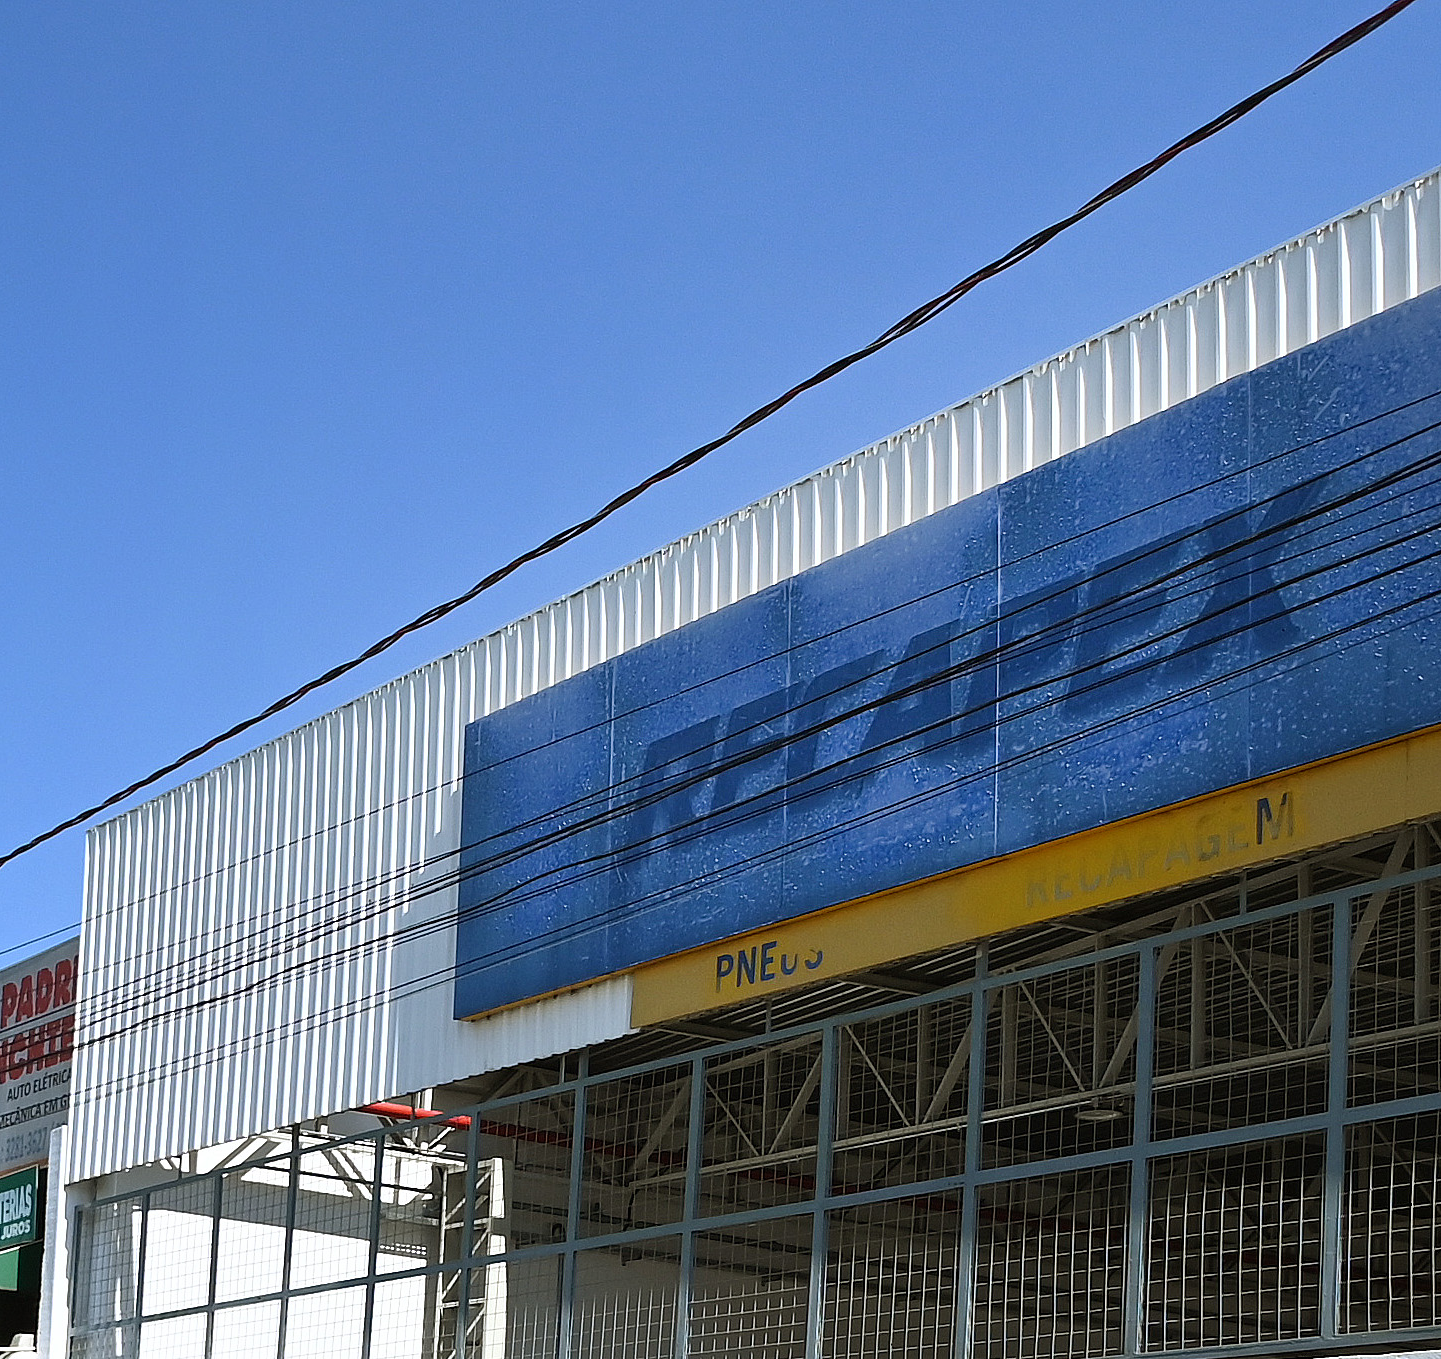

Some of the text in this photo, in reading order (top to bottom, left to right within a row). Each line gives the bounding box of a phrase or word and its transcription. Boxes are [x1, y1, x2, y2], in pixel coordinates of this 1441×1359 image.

[6, 1083, 31, 1103] AUTO
[42, 1097, 59, 1116] EM
[0, 1219, 32, 1241] JUROS
